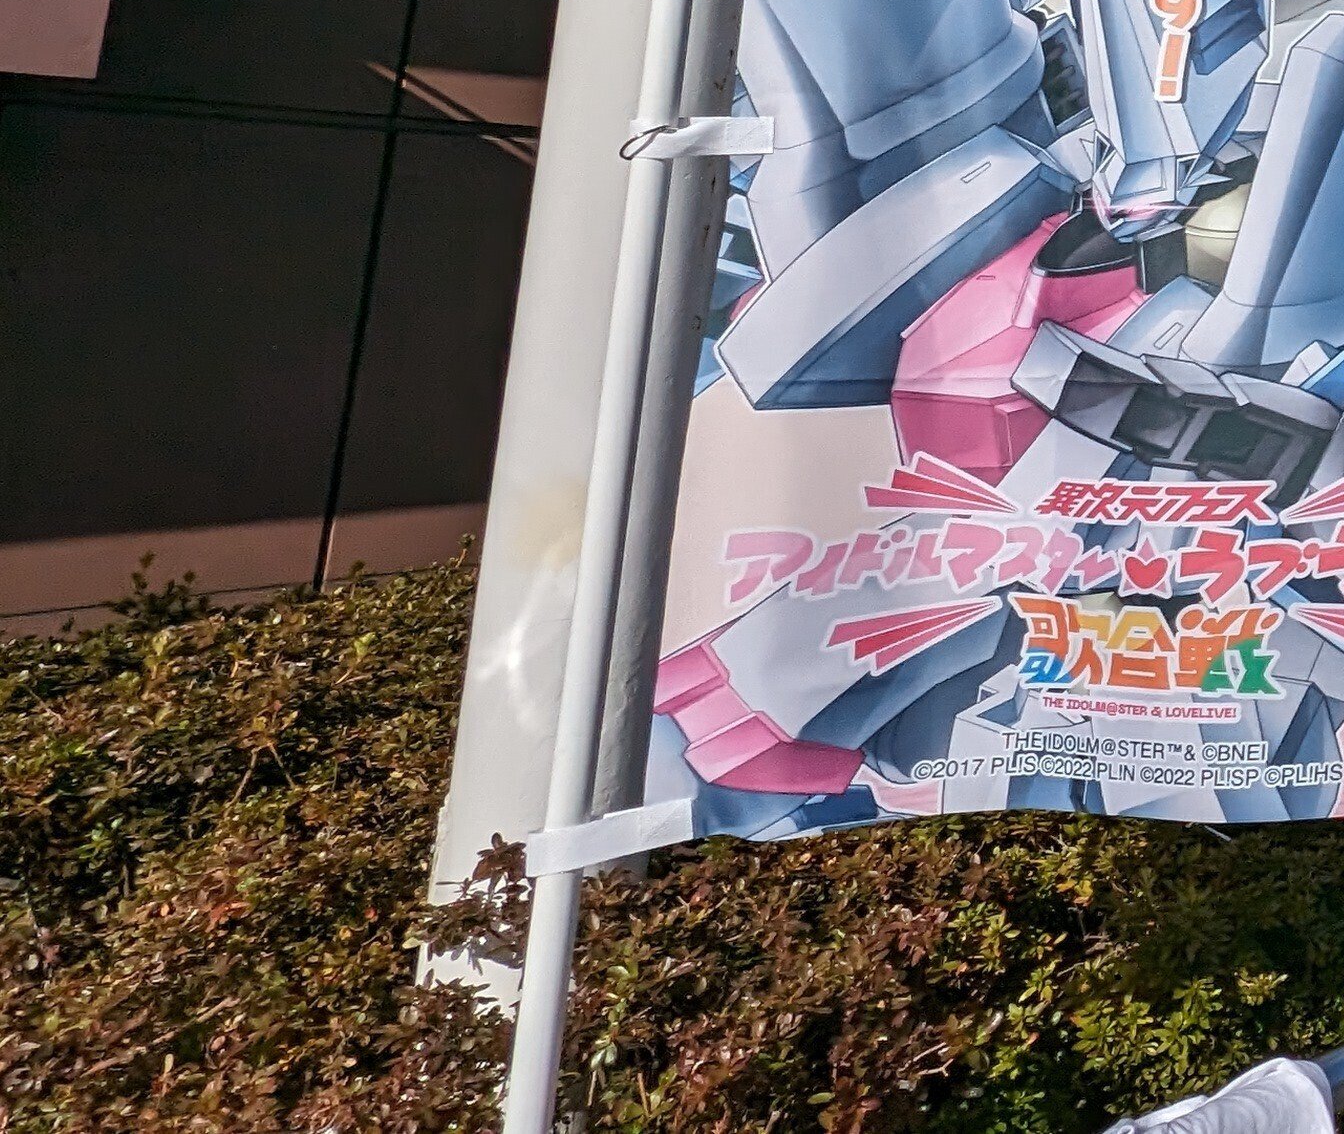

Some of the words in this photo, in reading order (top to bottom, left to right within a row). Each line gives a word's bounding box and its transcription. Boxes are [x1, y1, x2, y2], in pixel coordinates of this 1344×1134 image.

[1035, 480, 1278, 525] 異次元フェス
[722, 518, 1119, 604] アイドルマスター
[1008, 593, 1286, 698] 歌合戦
[1043, 696, 1063, 710] THE
[1066, 698, 1148, 717] IDOLM@STER
[1151, 706, 1161, 718] &
[1165, 706, 1237, 719] LOVELIVE!
[1002, 732, 1044, 751] THE
[1184, 745, 1197, 760] &
[1202, 742, 1268, 761] ©BNEI
[914, 758, 985, 778] ©2017
[990, 755, 1037, 774] PL!S
[1041, 757, 1095, 778] ©2022
[1098, 765, 1135, 782] PL!N
[1139, 767, 1195, 786] ©2022
[1200, 767, 1259, 788] PL!SP
[1265, 764, 1343, 785] ©PL!HS
